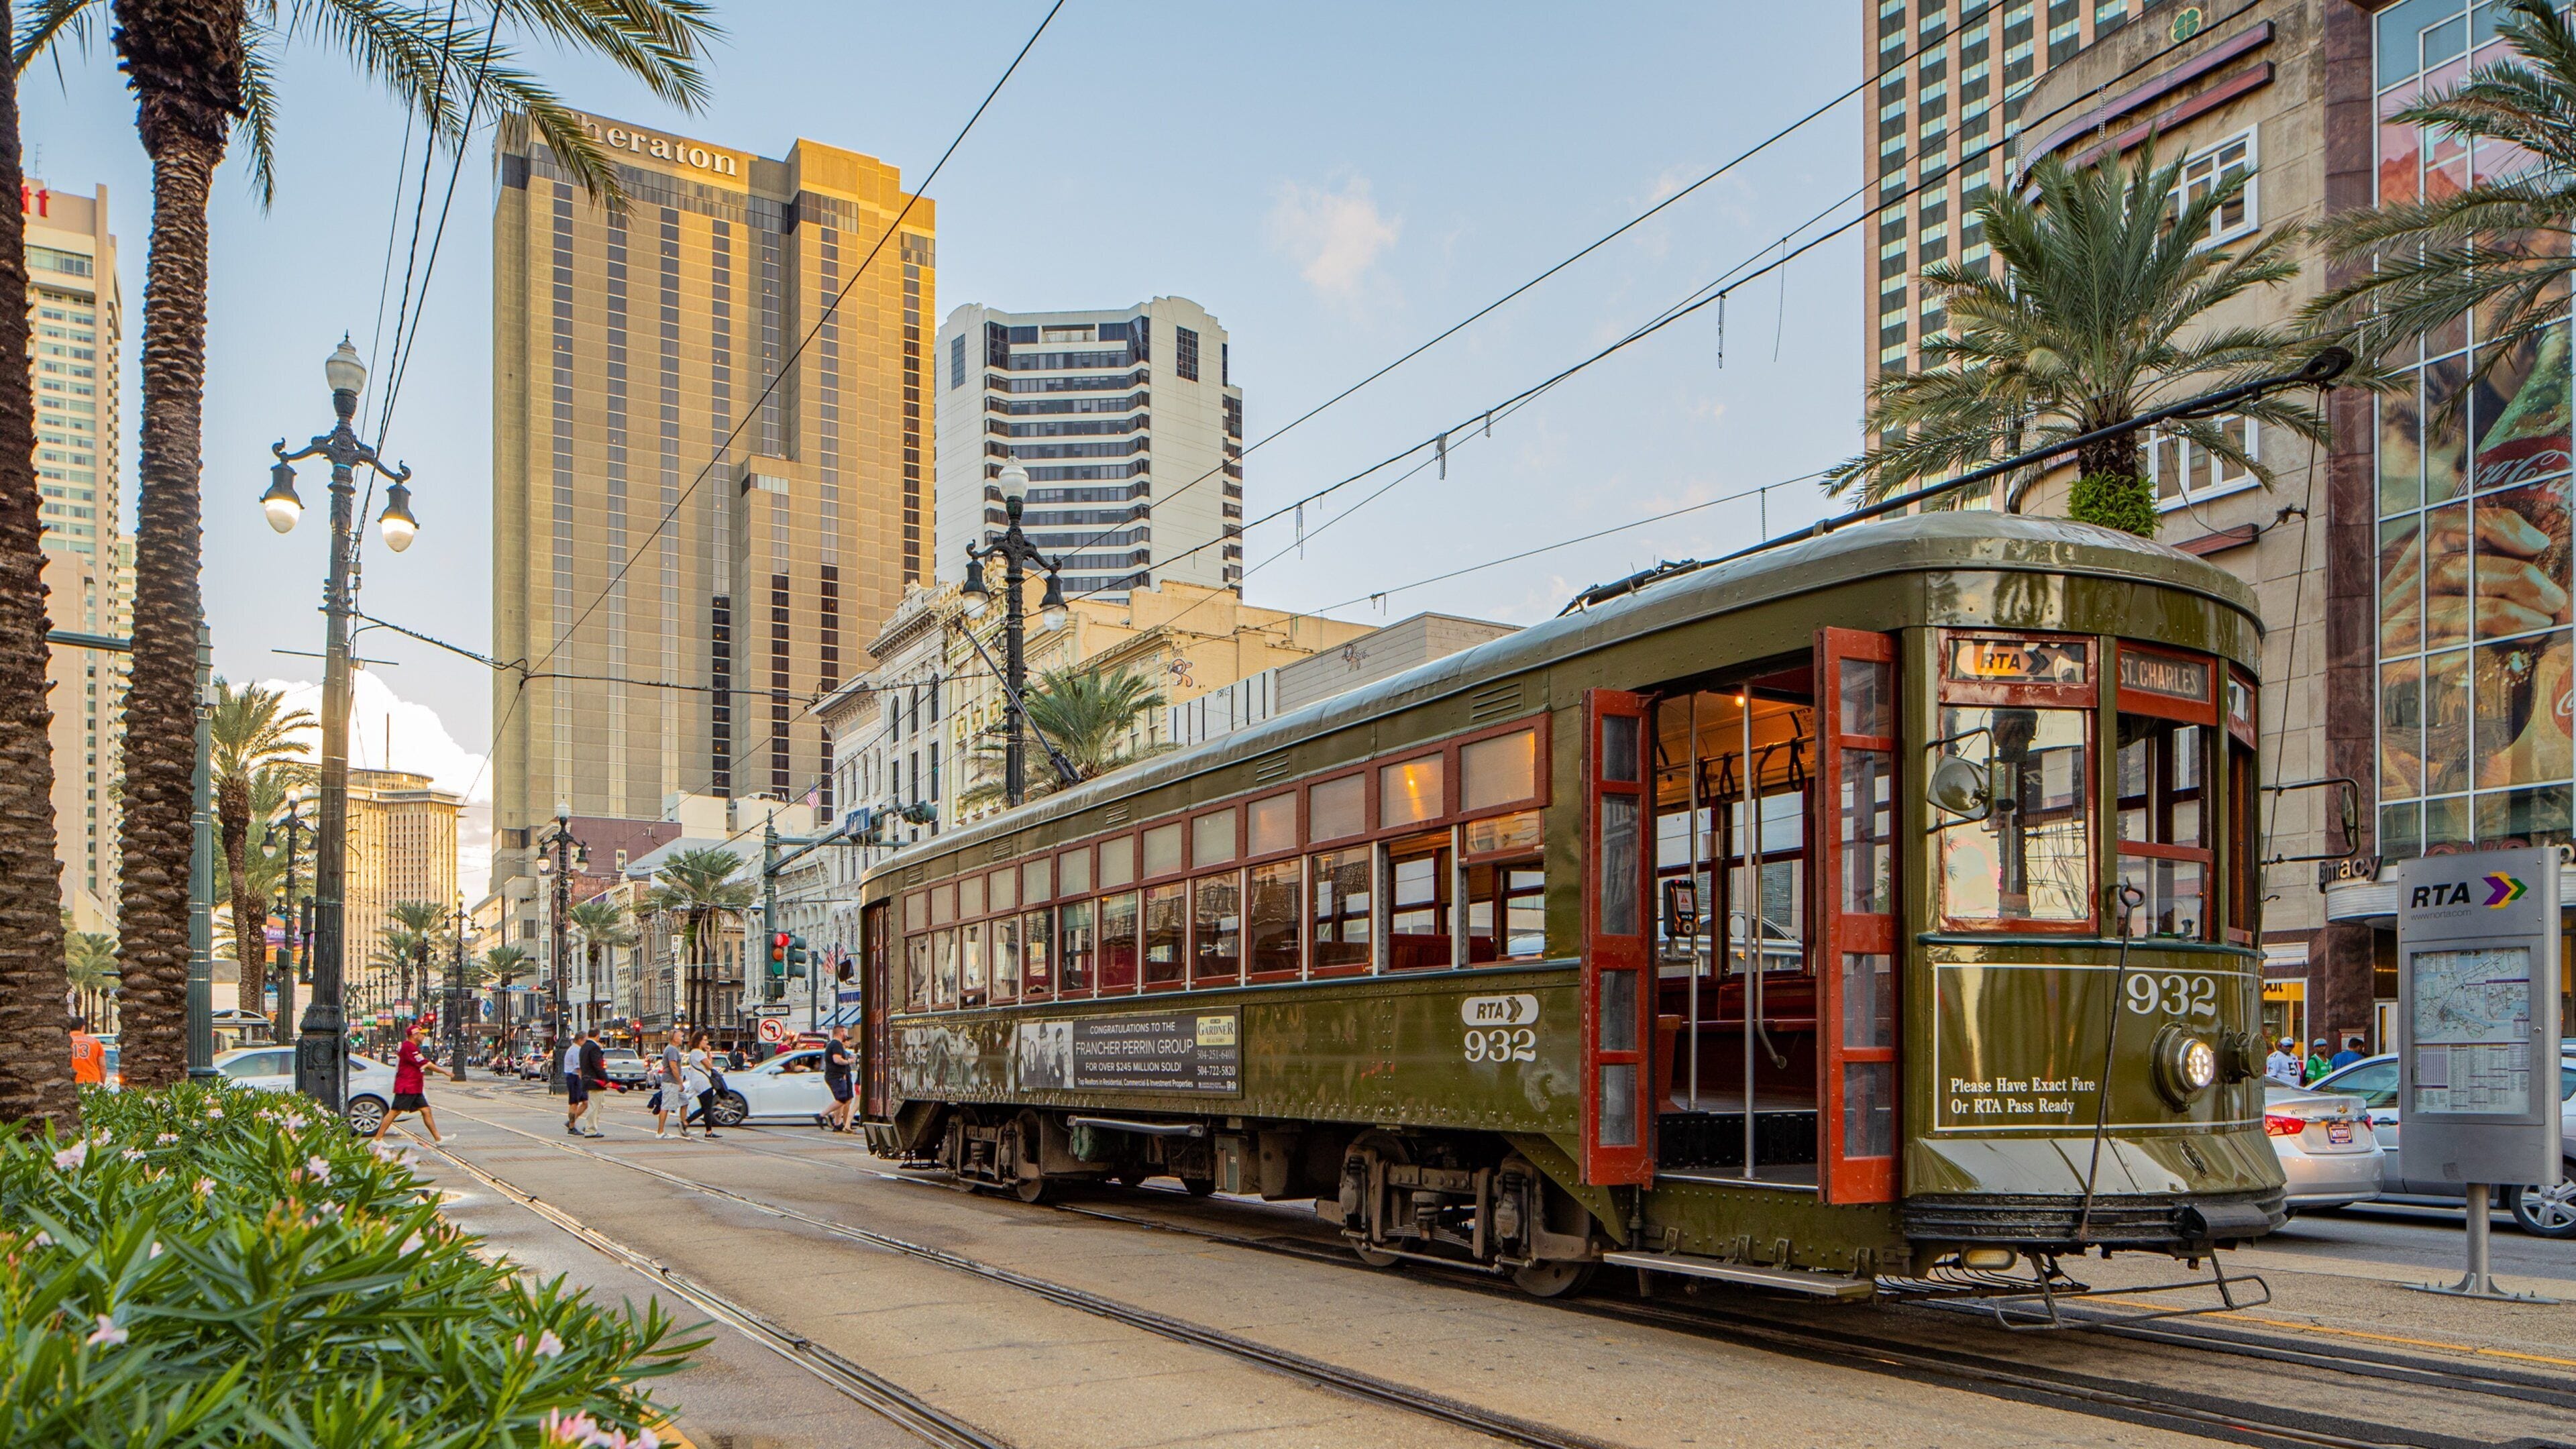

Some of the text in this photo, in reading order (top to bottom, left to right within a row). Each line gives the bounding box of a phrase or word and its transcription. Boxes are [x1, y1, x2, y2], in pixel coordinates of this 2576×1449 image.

[566, 109, 737, 176] heraton
[1980, 653, 2021, 669] RTA
[2121, 657, 2198, 696] ST. CHARLES
[2411, 882, 2471, 908] RTA
[2410, 909, 2471, 920] www.norta.com
[2127, 973, 2216, 1016] 932
[1477, 1002, 1503, 1019] RTA
[1089, 1022, 1175, 1034] CONGRATULATIONS TO THE
[1198, 1022, 1234, 1036] GARDNER
[73, 1043, 89, 1059] 13
[1075, 1038, 1193, 1055] FRANCHER PERRIN GROUP
[1464, 1028, 1536, 1062] 932
[906, 1046, 928, 1065] 932
[1197, 1049, 1235, 1059] 504-251-6400
[1085, 1062, 1182, 1071] FOR OVER $245 MILLION SOLD!
[1197, 1065, 1236, 1076] 504-722-5820
[1124, 1078, 1145, 1086] Commercial
[1150, 1079, 1172, 1087] Investment
[1172, 1079, 1193, 1088] Properties
[1950, 1076, 2096, 1093] Please Have Exact Fare
[1951, 1097, 2075, 1115] Or RTA Pass Ready
